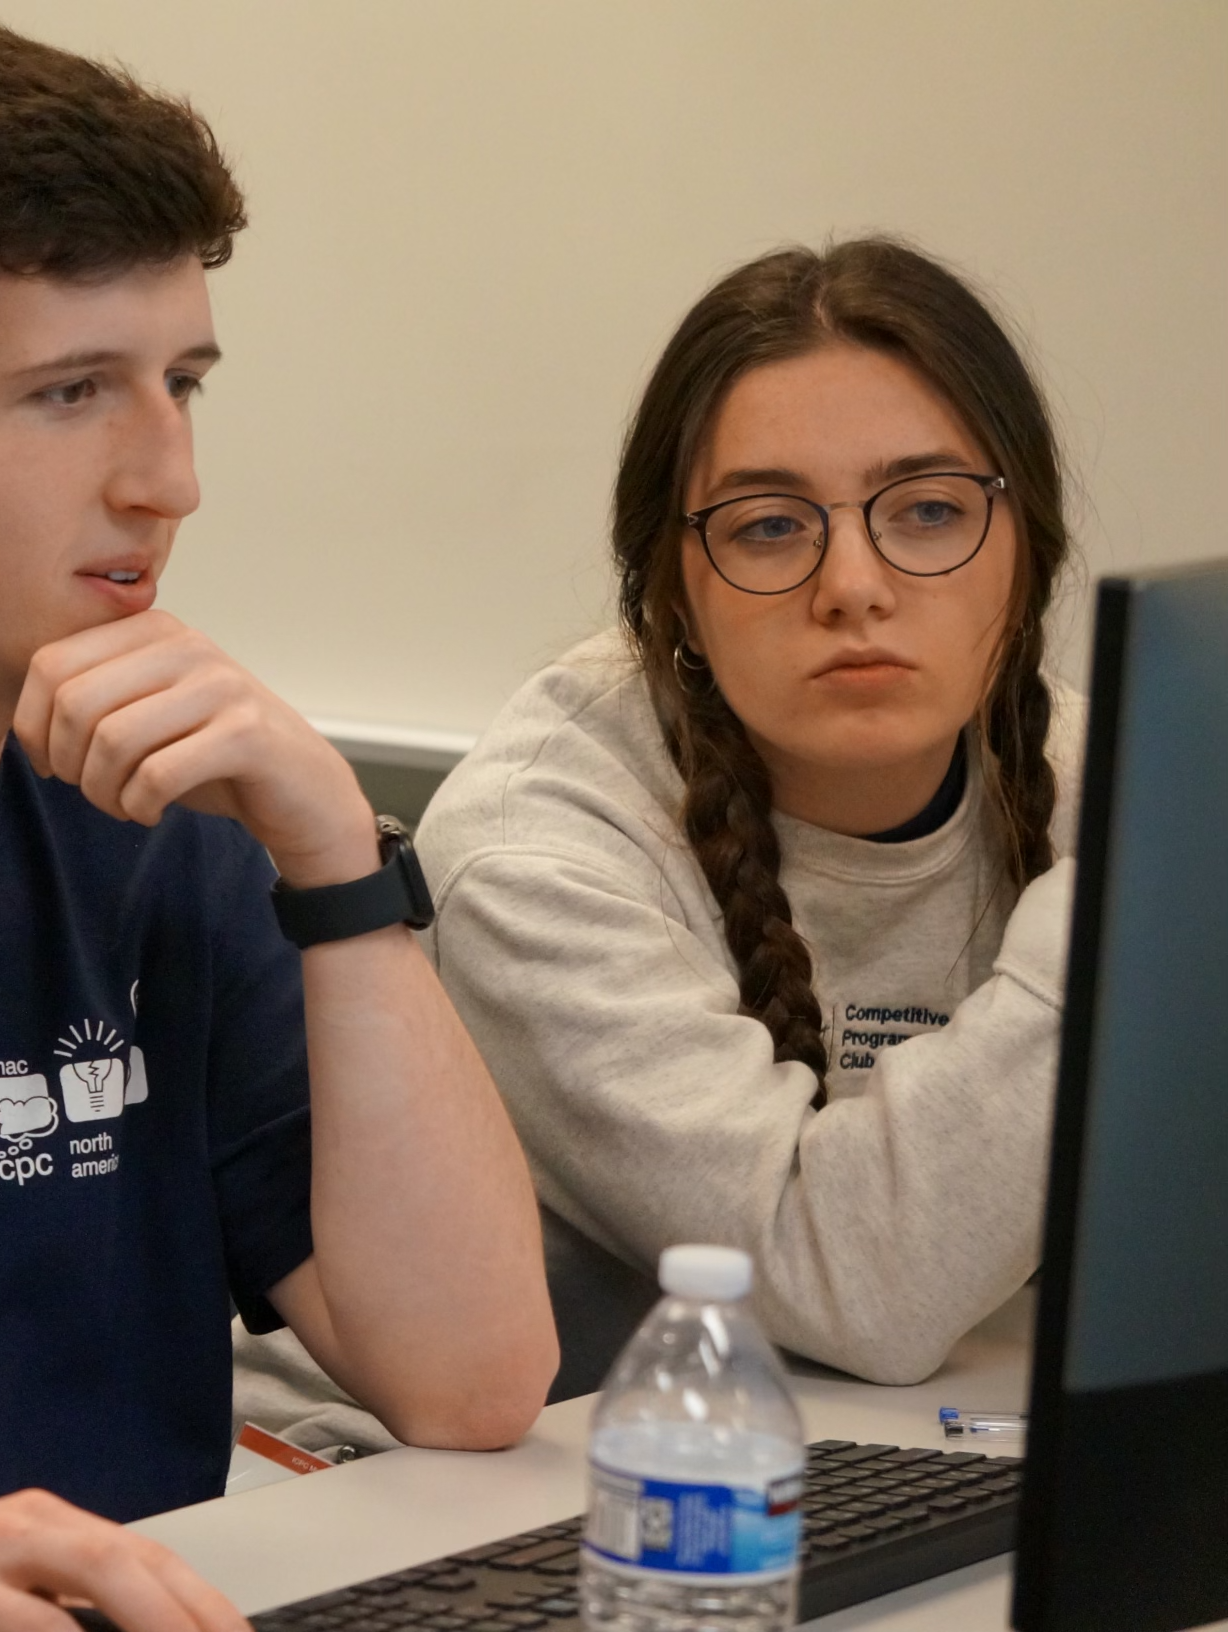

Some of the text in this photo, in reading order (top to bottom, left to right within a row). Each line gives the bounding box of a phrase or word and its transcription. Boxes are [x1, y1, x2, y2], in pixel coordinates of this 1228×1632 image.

[845, 1004, 950, 1026] Competitive
[839, 1052, 875, 1070] Club
[70, 1131, 113, 1155] north
